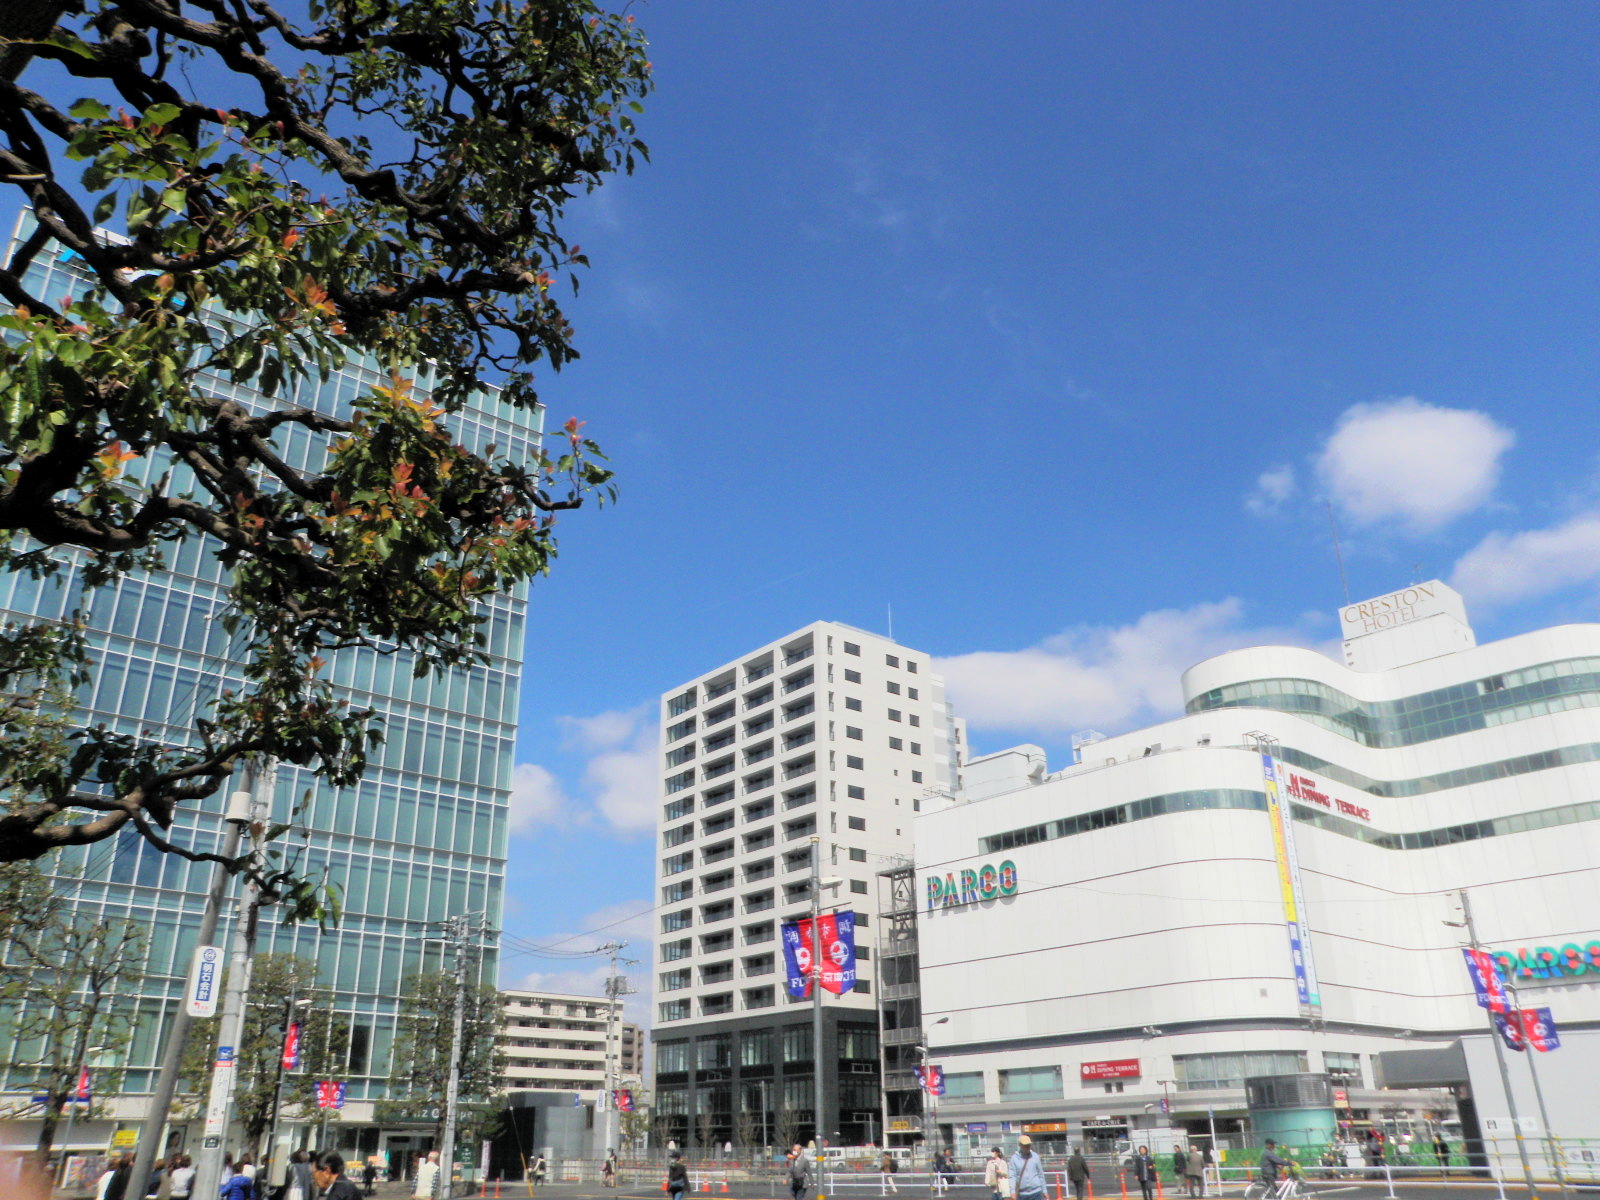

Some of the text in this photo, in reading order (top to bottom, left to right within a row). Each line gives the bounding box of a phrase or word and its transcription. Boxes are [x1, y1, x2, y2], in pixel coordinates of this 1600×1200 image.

[1344, 583, 1436, 623] CRESTON
[1364, 605, 1420, 632] HOTEL
[1335, 798, 1371, 821] TERRACE
[926, 859, 1018, 909] PARCO
